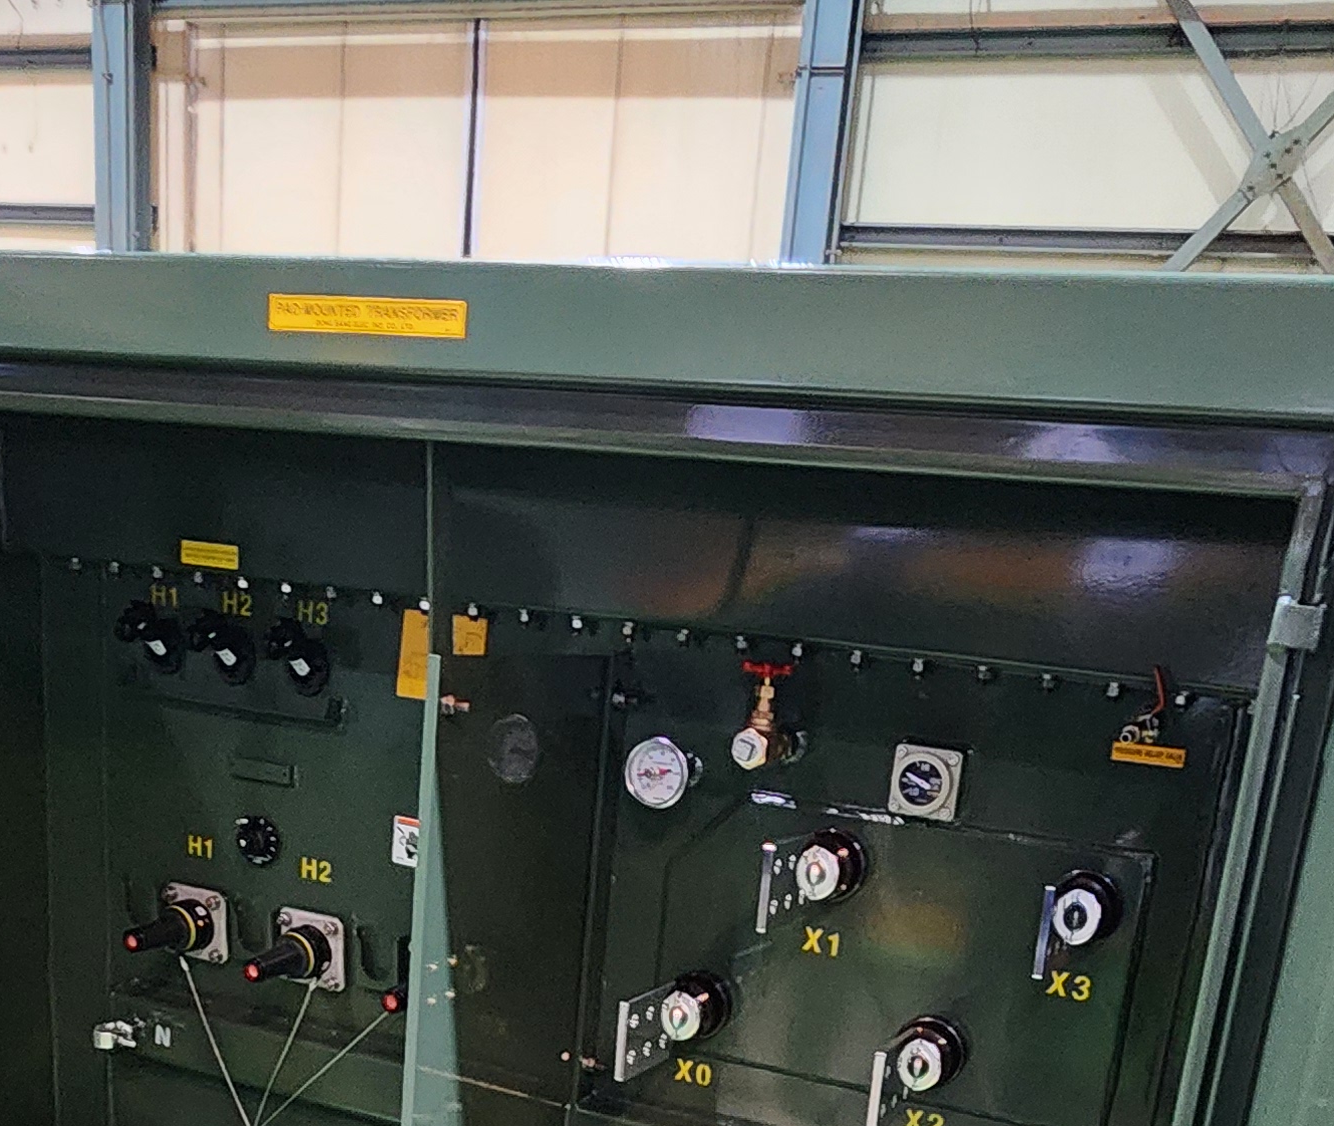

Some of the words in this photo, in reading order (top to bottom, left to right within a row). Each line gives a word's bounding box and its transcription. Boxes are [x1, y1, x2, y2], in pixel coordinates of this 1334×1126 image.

[275, 301, 361, 318] PAD-MOUNTED
[365, 304, 458, 321] TRANSFORMER
[150, 583, 178, 608] H1
[221, 590, 252, 617] H2
[296, 600, 329, 625] H3
[187, 834, 213, 859] H1
[300, 856, 333, 883] H2
[801, 925, 840, 957] X1
[1045, 970, 1091, 1001] X3
[155, 1024, 171, 1048] N
